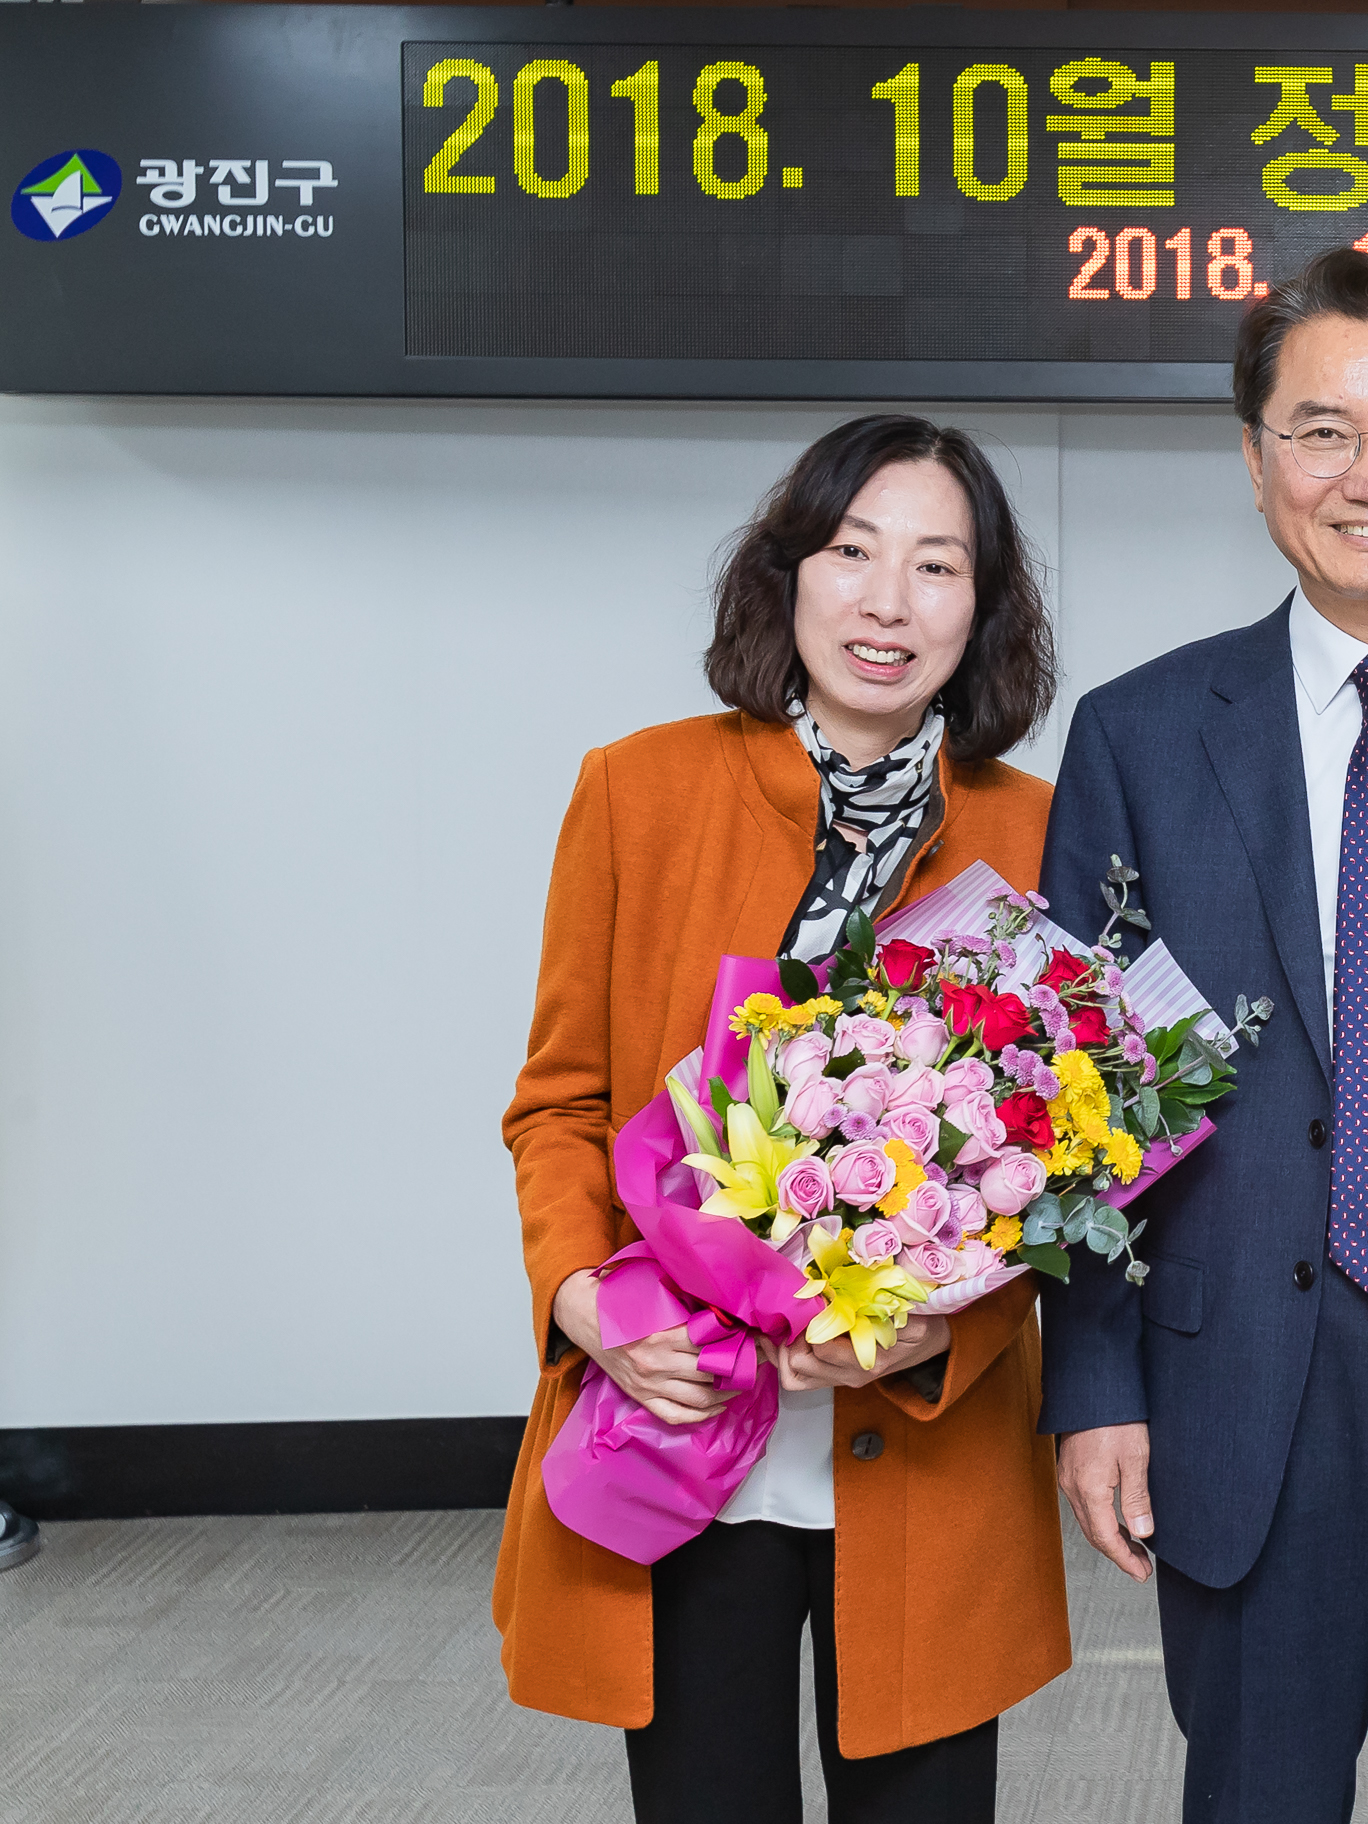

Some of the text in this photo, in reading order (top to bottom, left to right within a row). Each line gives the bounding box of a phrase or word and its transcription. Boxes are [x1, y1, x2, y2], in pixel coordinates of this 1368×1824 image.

[422, 58, 803, 200] 2018.
[871, 54, 1176, 208] 10월
[135, 158, 339, 208] 광진구
[138, 214, 335, 238] GWANGJIN-GU
[1067, 226, 1269, 301] 2018.
